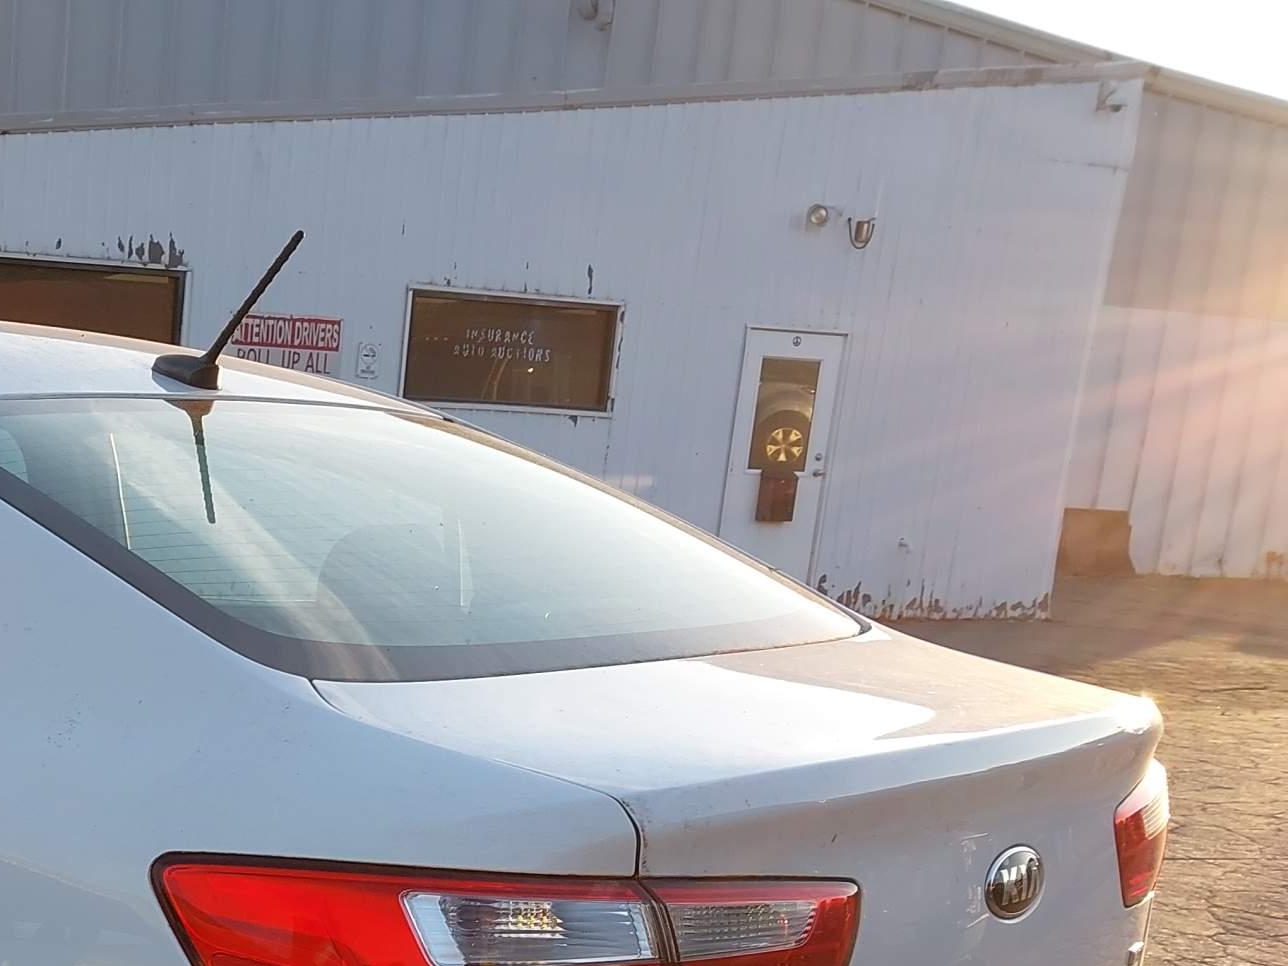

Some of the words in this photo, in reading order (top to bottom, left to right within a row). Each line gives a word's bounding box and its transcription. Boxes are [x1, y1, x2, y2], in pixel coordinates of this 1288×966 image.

[232, 318, 293, 345] ATTENTION
[294, 321, 339, 348] DRIVERS
[466, 328, 535, 344] INSURANCE
[281, 350, 300, 369] UP
[304, 352, 330, 374] ALL
